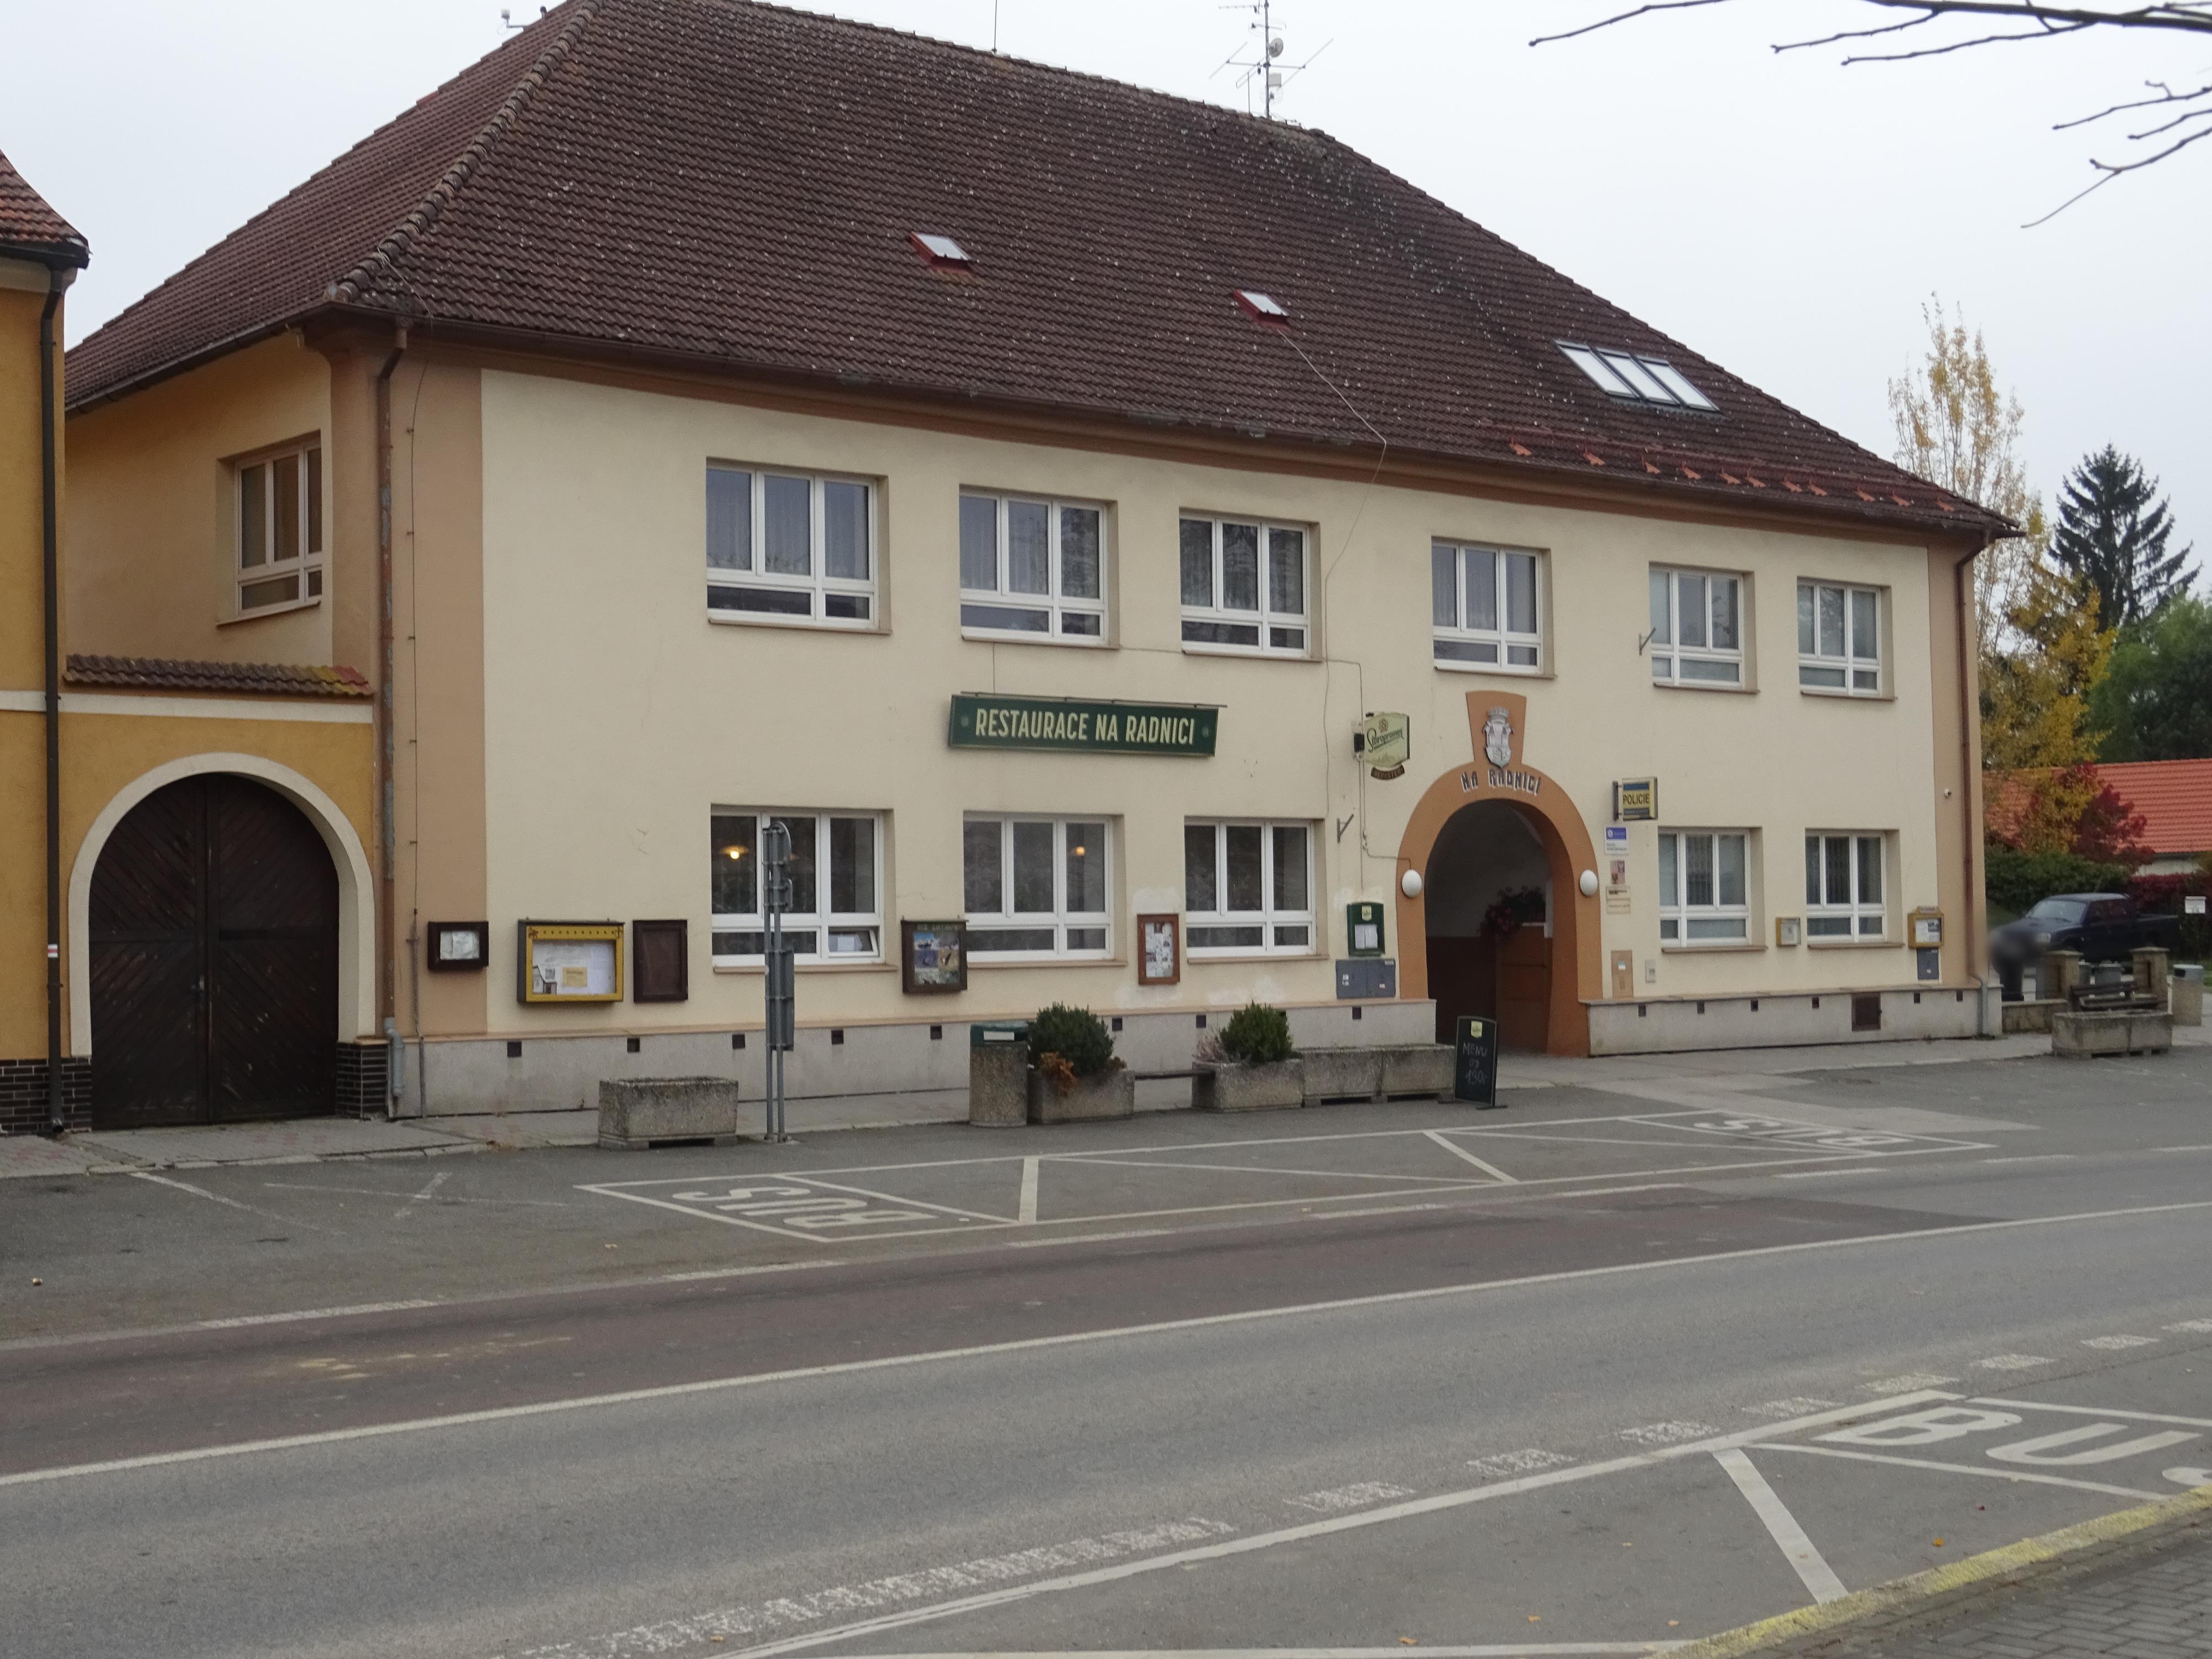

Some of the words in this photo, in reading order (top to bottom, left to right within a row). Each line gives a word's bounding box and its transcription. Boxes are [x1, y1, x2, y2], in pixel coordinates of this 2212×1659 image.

[975, 707, 1089, 740] RESTAURACE
[1095, 713, 1118, 742] NA
[1125, 715, 1195, 745] RADNICI
[1460, 770, 1478, 793] NA
[1488, 769, 1542, 796] RADNICI
[1623, 792, 1650, 806] POLICIE
[1463, 1041, 1488, 1057] MENU
[672, 1186, 937, 1229] BUS
